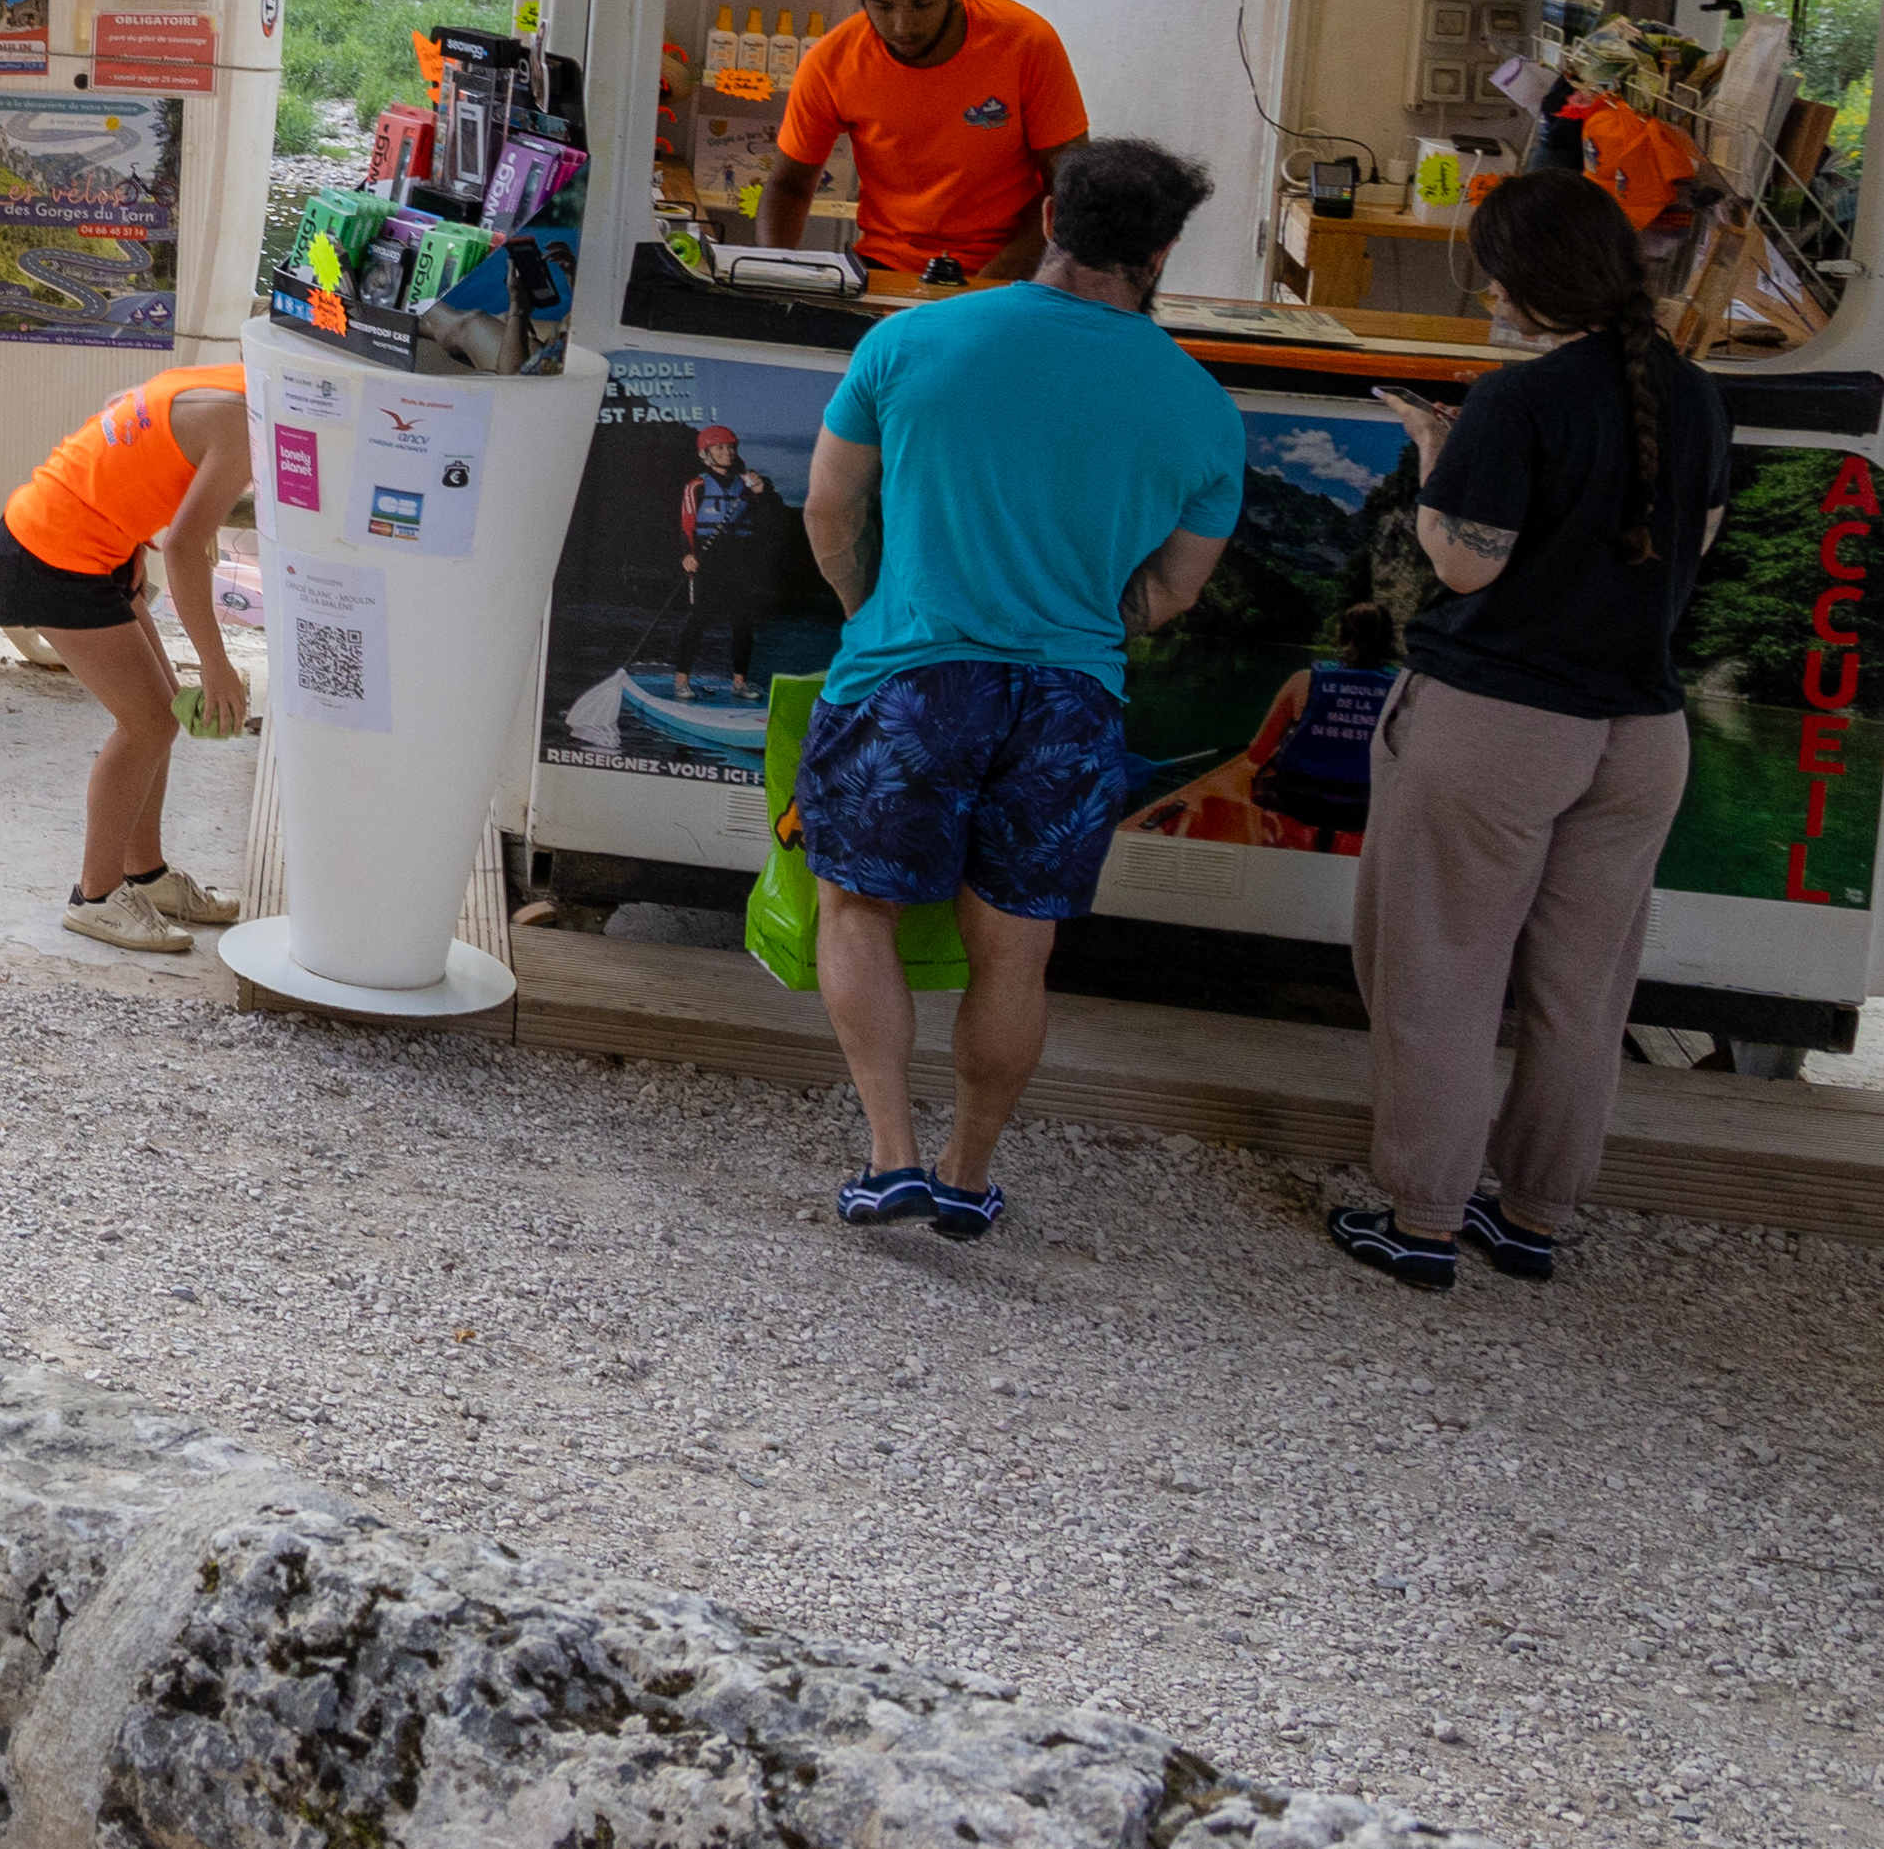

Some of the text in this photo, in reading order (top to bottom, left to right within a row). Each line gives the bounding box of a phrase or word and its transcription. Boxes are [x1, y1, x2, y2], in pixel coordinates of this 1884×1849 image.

[114, 16, 198, 27] OBLIGATOIRE
[446, 38, 487, 60] seawag
[52, 171, 129, 207] vélos
[4, 203, 155, 223] des Gorges du Tarn
[81, 226, 93, 234] 04
[95, 227, 108, 235] 66
[109, 227, 121, 236] 48
[134, 228, 144, 237] 14
[392, 330, 411, 344] CASE
[613, 362, 695, 378] PADDLE
[633, 406, 703, 423] FACILE
[280, 445, 311, 467] lonely
[280, 459, 312, 477] planet
[339, 594, 376, 606] MOULIN
[1784, 454, 1880, 903] ACCUEIL
[1339, 684, 1386, 698] MOULIN
[1336, 697, 1371, 710] DE LA
[547, 748, 719, 782] RENSEIGNEZ-VOUS
[723, 764, 747, 784] ICI
